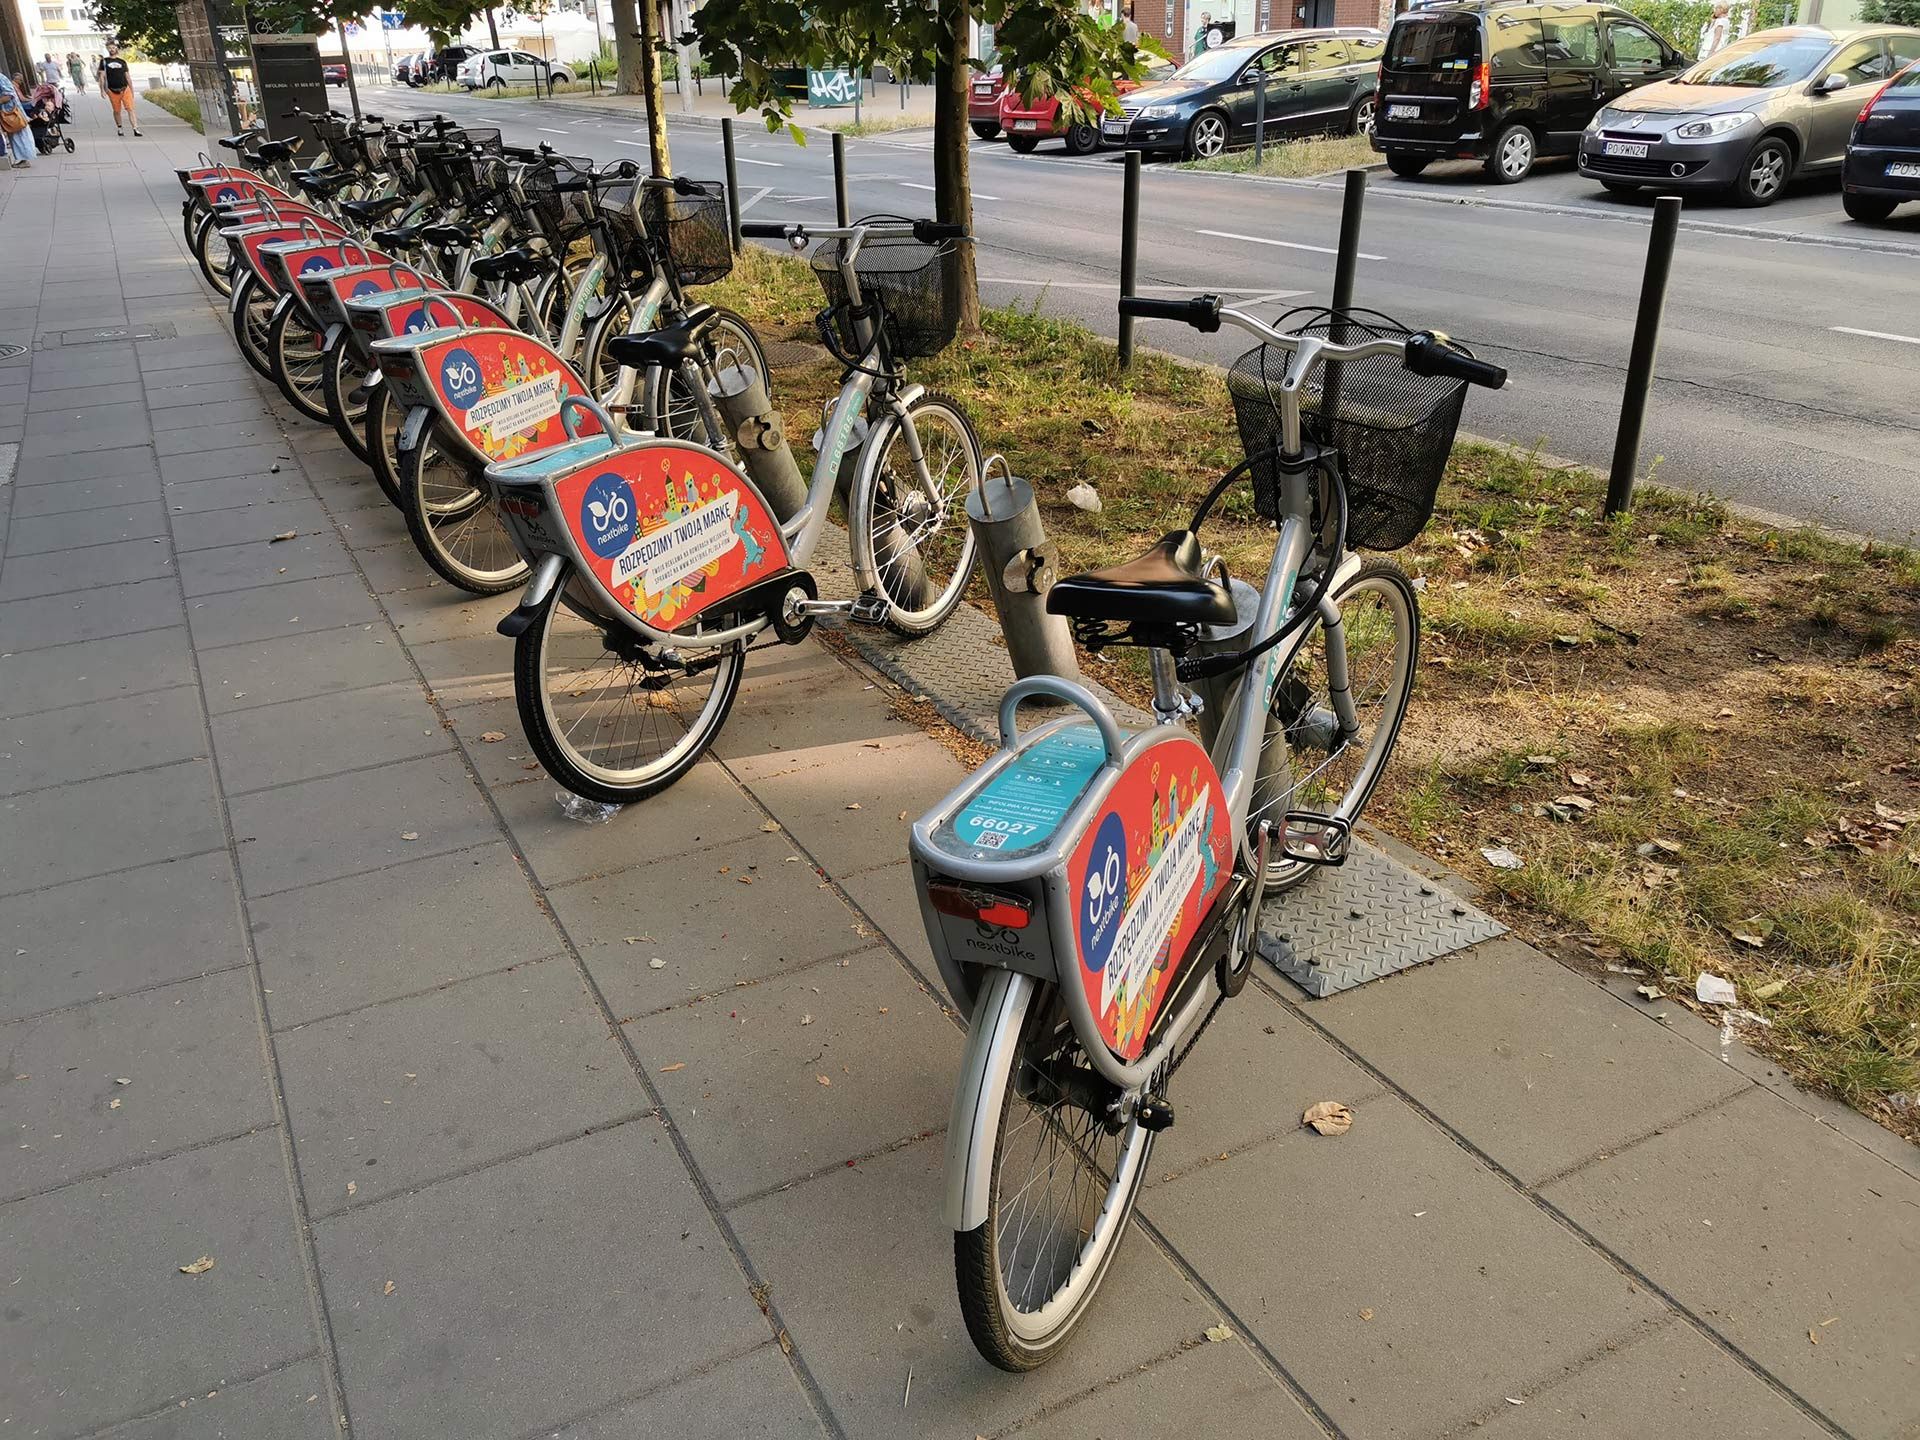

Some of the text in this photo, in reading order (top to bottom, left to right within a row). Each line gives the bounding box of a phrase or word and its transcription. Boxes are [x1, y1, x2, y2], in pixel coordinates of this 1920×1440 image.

[1608, 143, 1646, 157] PO 9WN24
[1891, 162, 1910, 176] PO
[597, 522, 630, 546] nextbike
[619, 532, 673, 577] ROZPĘDZIMY
[674, 517, 703, 545] TWOJĄ
[969, 816, 1037, 836] 66027
[1091, 895, 1119, 951] nextbike
[1108, 884, 1153, 990] ROZPĘDZIMY
[1155, 847, 1177, 902] TWOJĄ
[966, 938, 1036, 961] nextbike
